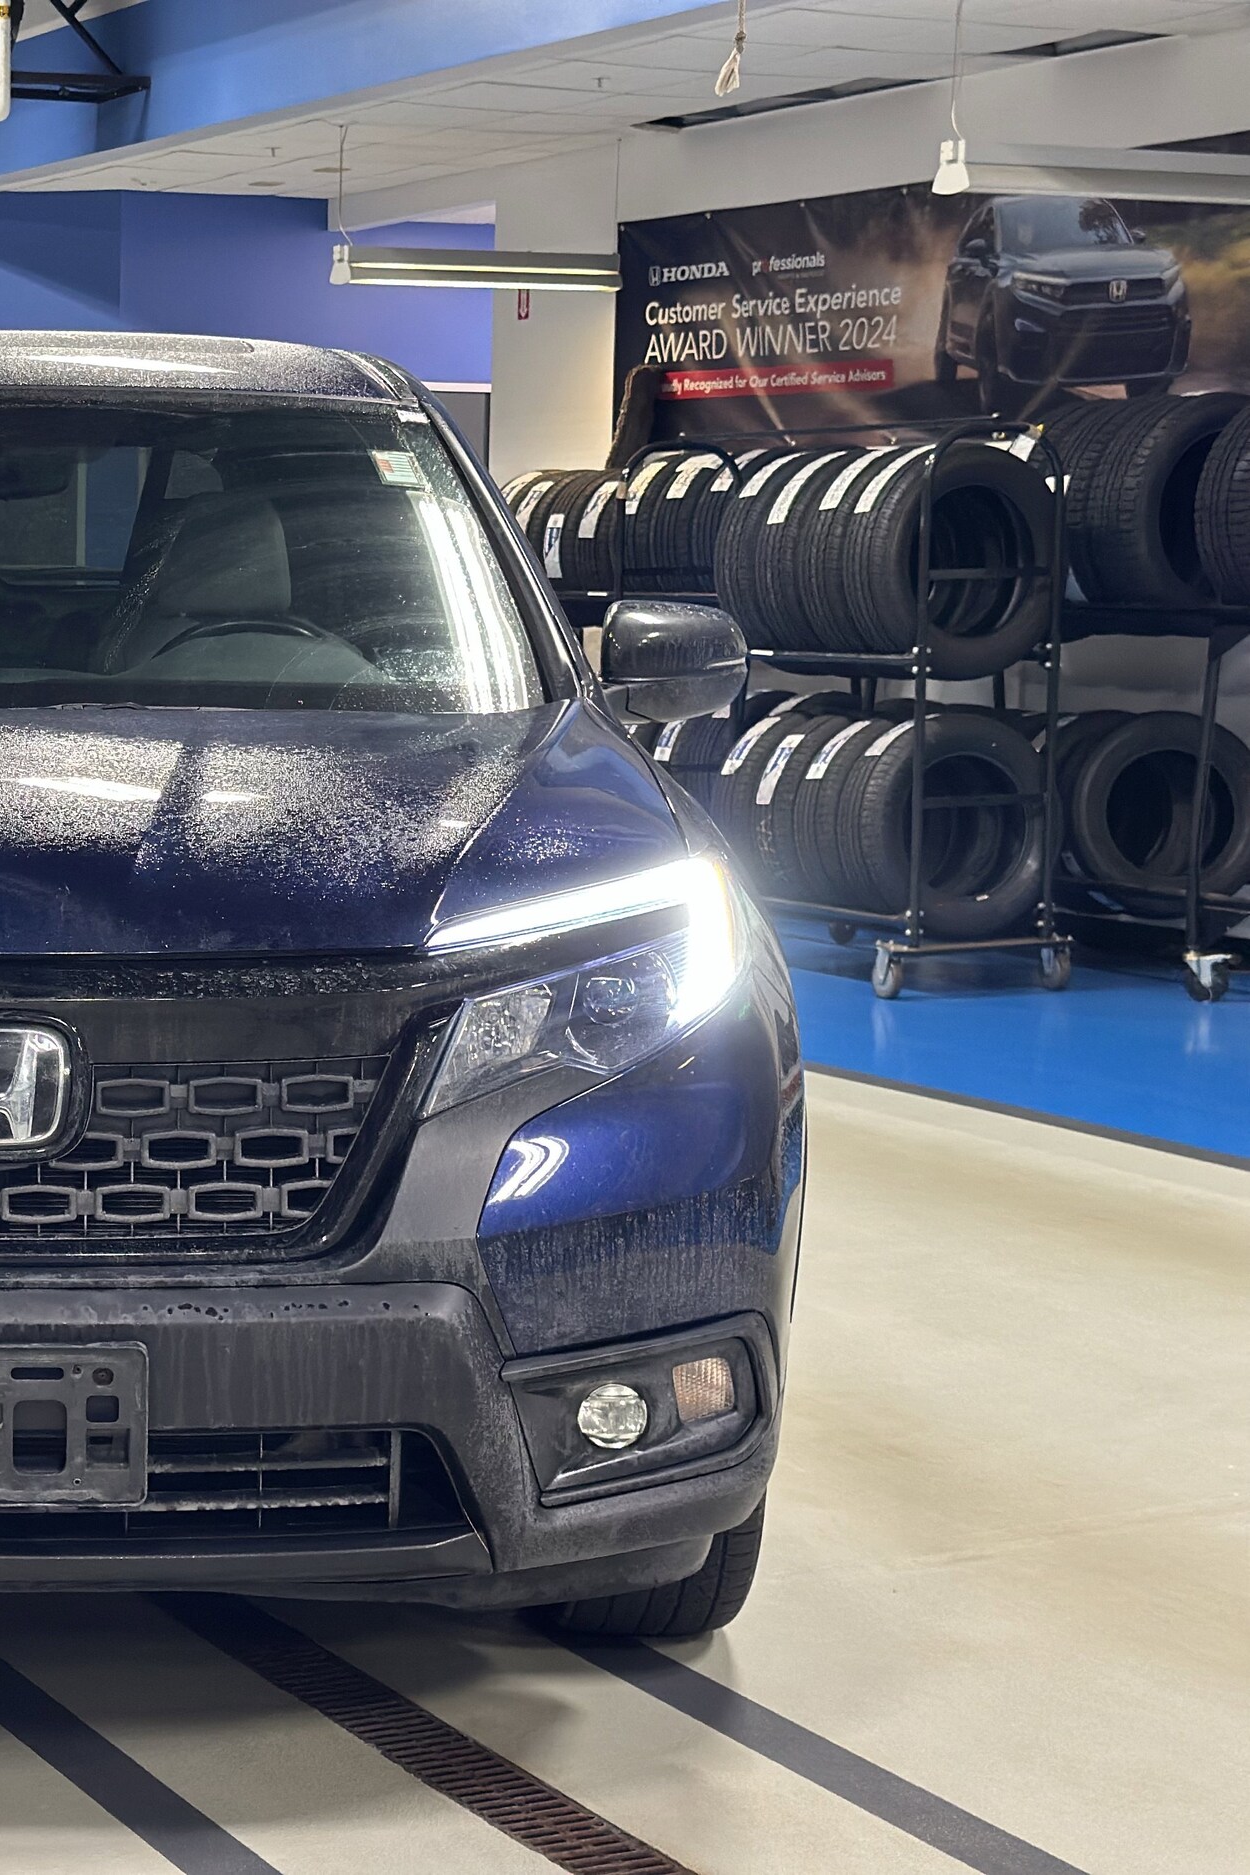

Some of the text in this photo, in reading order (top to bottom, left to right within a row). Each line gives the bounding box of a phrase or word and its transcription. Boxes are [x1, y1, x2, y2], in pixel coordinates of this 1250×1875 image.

[662, 261, 730, 283] HONDA
[645, 284, 902, 326] Customer Service Experience
[644, 314, 898, 364] AWARD WINNER 2024
[683, 376, 734, 394] Recognized
[735, 375, 747, 389] for
[749, 374, 769, 389] Our
[770, 372, 809, 387] Certified
[810, 371, 846, 385] Service
[848, 368, 886, 383] Advisors
